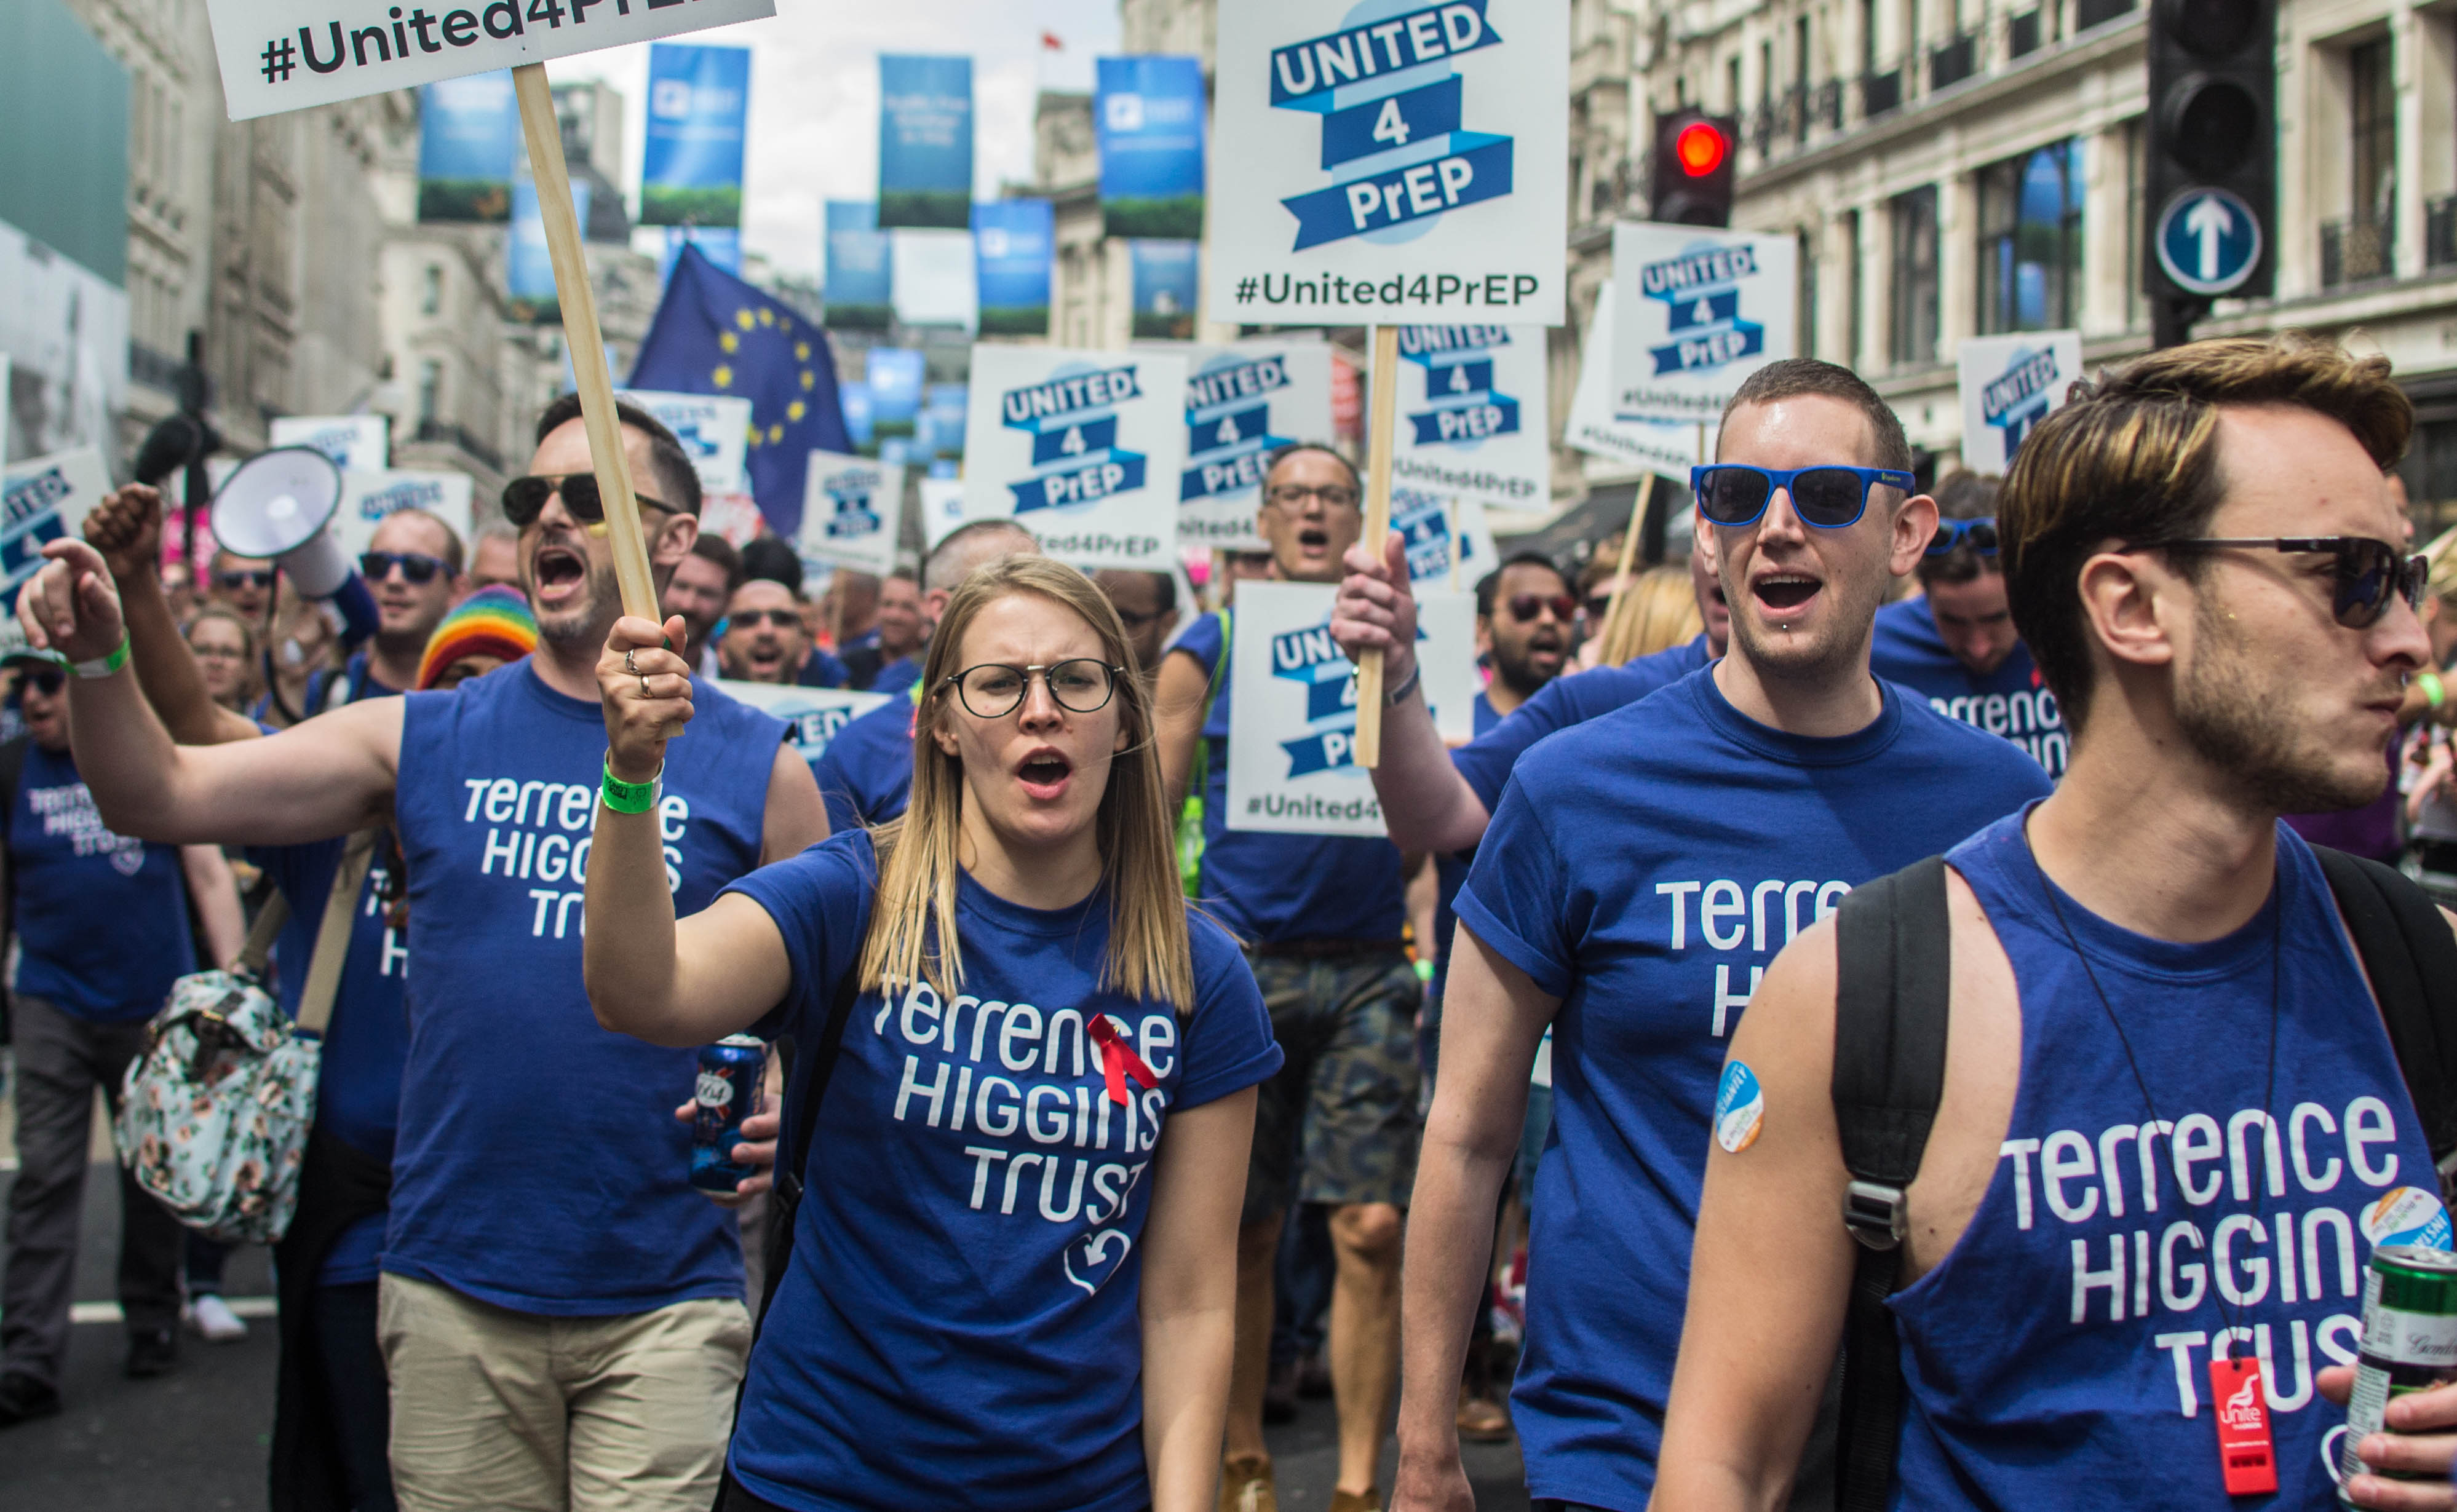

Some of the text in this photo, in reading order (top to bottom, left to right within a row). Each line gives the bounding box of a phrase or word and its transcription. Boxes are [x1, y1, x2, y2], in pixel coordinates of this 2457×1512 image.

[1275, 3, 1482, 95] UNITED
[1372, 97, 1410, 145] 4
[1346, 156, 1474, 231] PrEP
[1235, 272, 1539, 306] #United4PrEP
[1645, 248, 1753, 293] UNITED
[1693, 297, 1715, 323] 4
[1677, 330, 1747, 368] PrEP
[1006, 371, 1133, 422] UNITED
[1186, 360, 1282, 409] NITED
[1449, 365, 1470, 394] 4
[1985, 354, 2055, 417] UNITED
[1623, 389, 1731, 411] #United4
[1061, 425, 1087, 456] 4
[1217, 416, 1241, 443] 4
[1437, 405, 1504, 441] PrEP
[1046, 467, 1125, 506] PrEP
[1392, 459, 1538, 497] United4PrEP
[464, 777, 689, 842] Terree
[1247, 794, 1379, 820] #United4
[1655, 879, 1854, 951] Terre
[2000, 1095, 2399, 1230] Terrence
